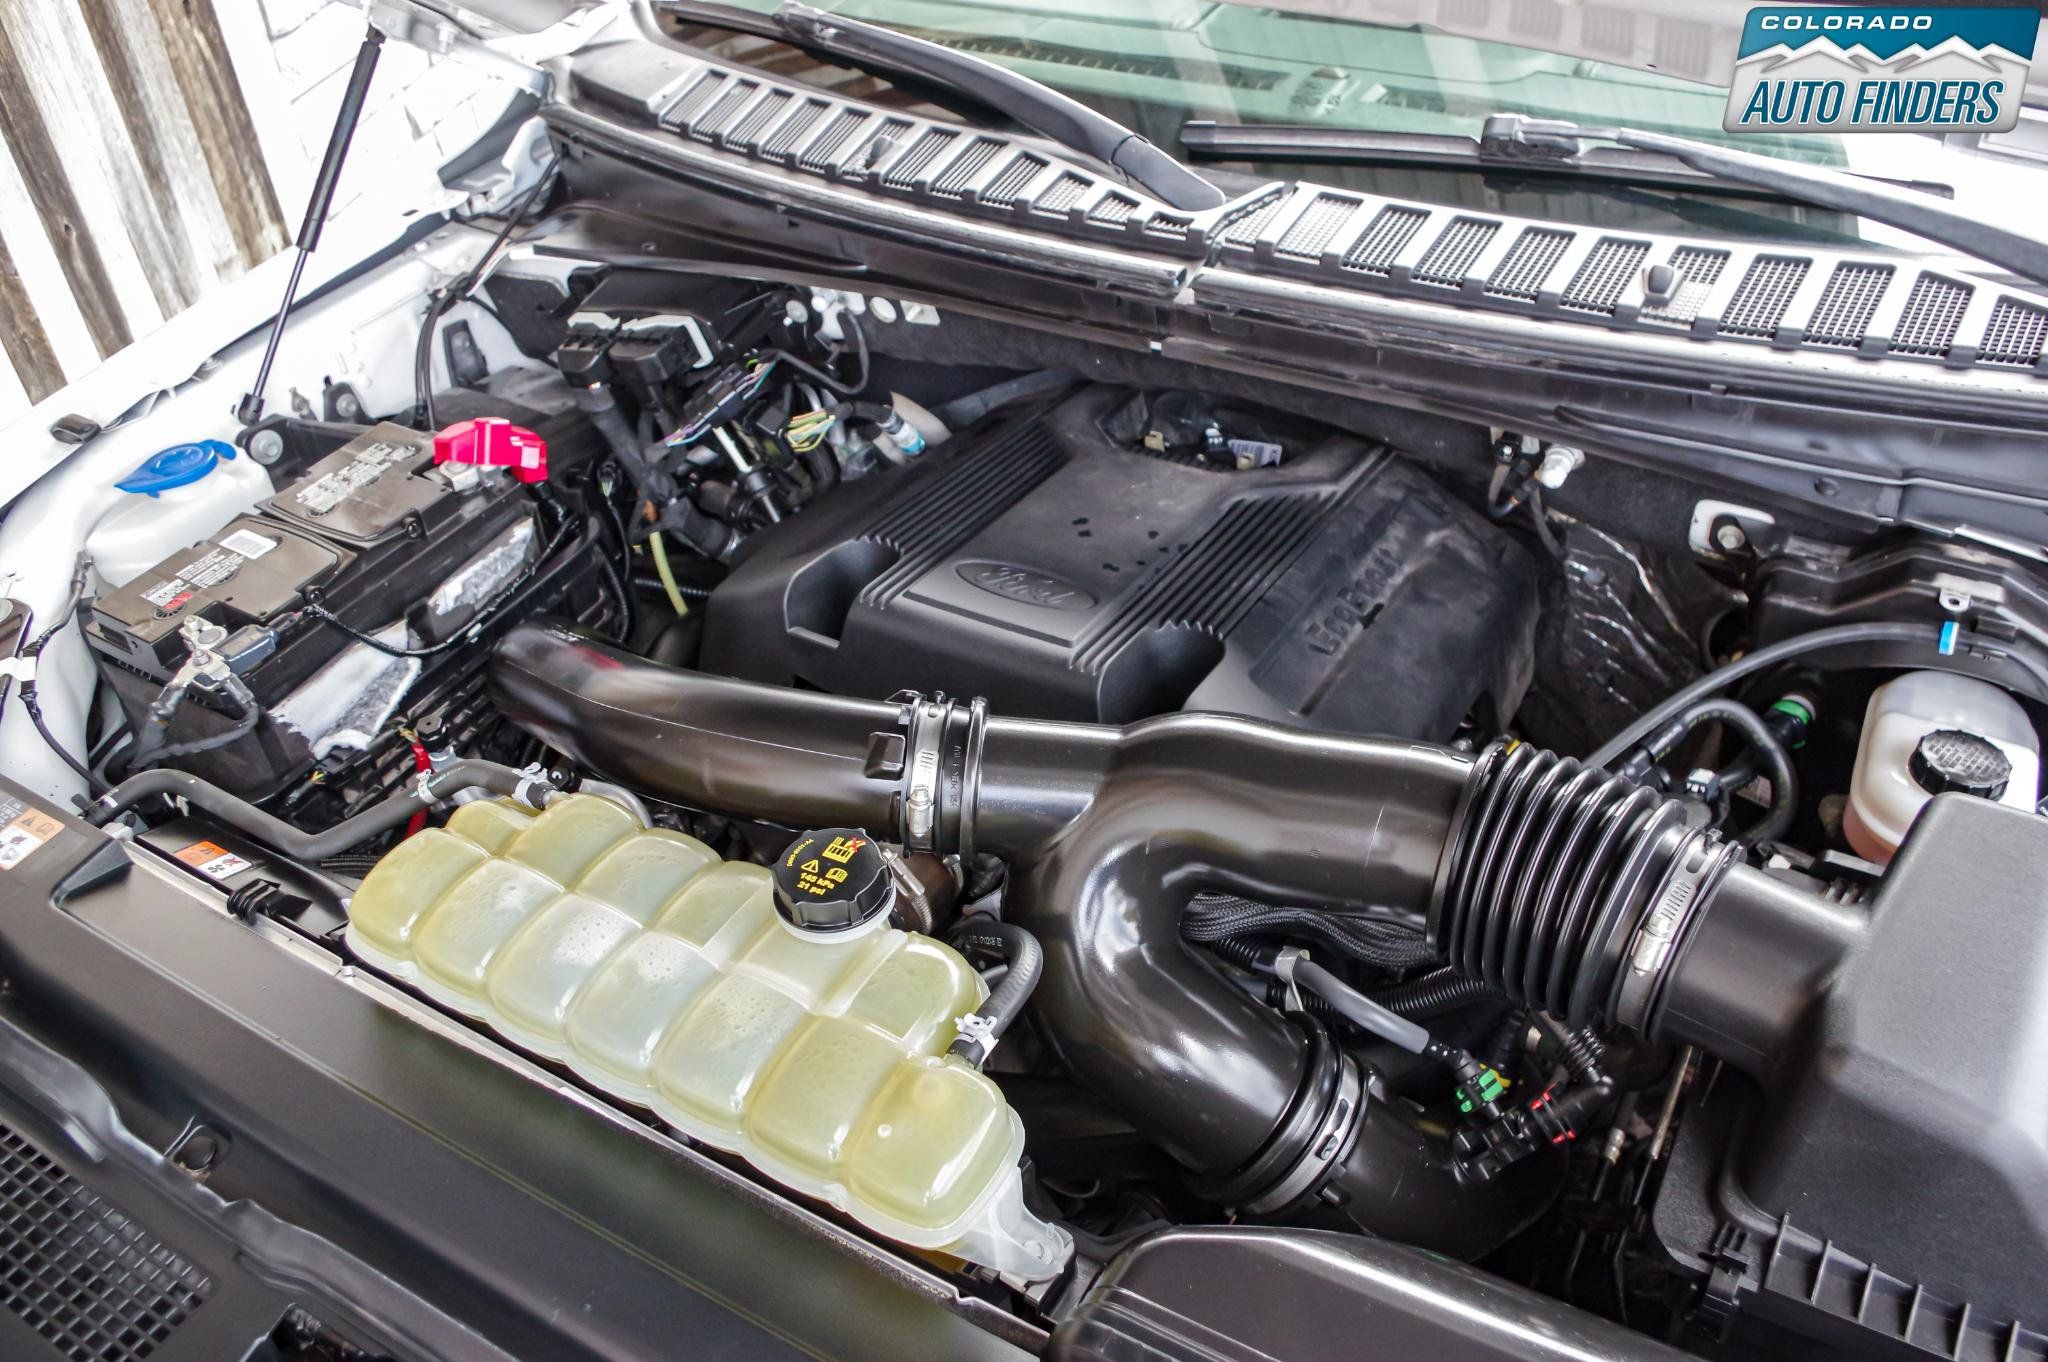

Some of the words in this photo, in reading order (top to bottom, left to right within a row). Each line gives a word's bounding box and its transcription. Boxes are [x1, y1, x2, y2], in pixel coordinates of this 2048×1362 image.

[974, 567, 1076, 604] Ford
[800, 872, 818, 883] 145
[796, 880, 811, 891] 21
[809, 885, 827, 896] psi
